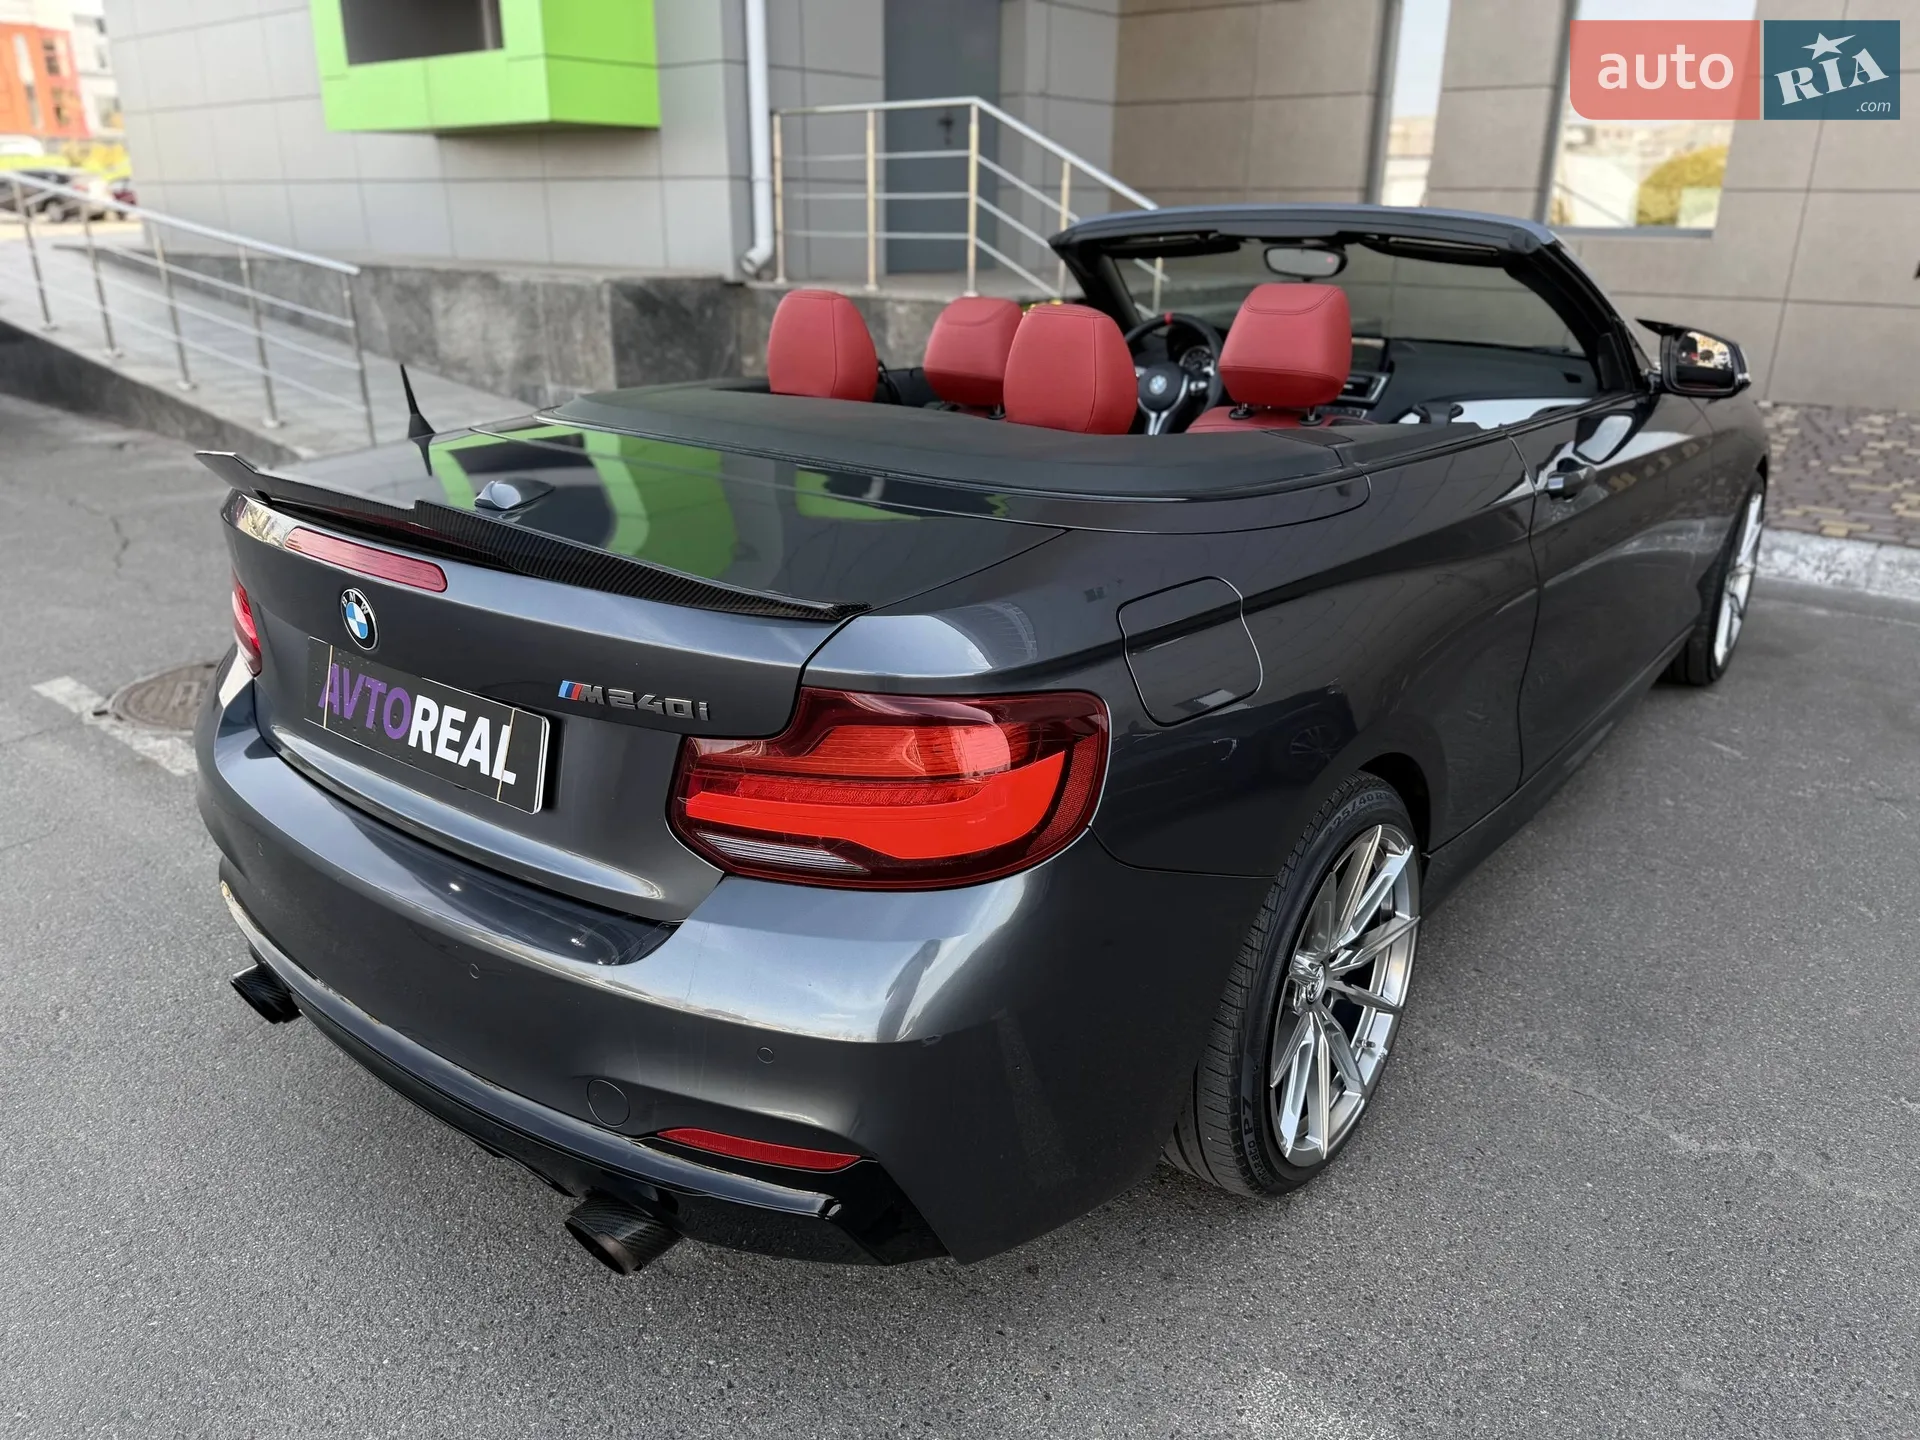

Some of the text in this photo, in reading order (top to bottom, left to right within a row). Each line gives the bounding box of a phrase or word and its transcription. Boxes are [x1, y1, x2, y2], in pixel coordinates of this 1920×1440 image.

[341, 591, 369, 615] BMW
[578, 683, 710, 721] M240i
[318, 662, 517, 785] AVTOREAL
